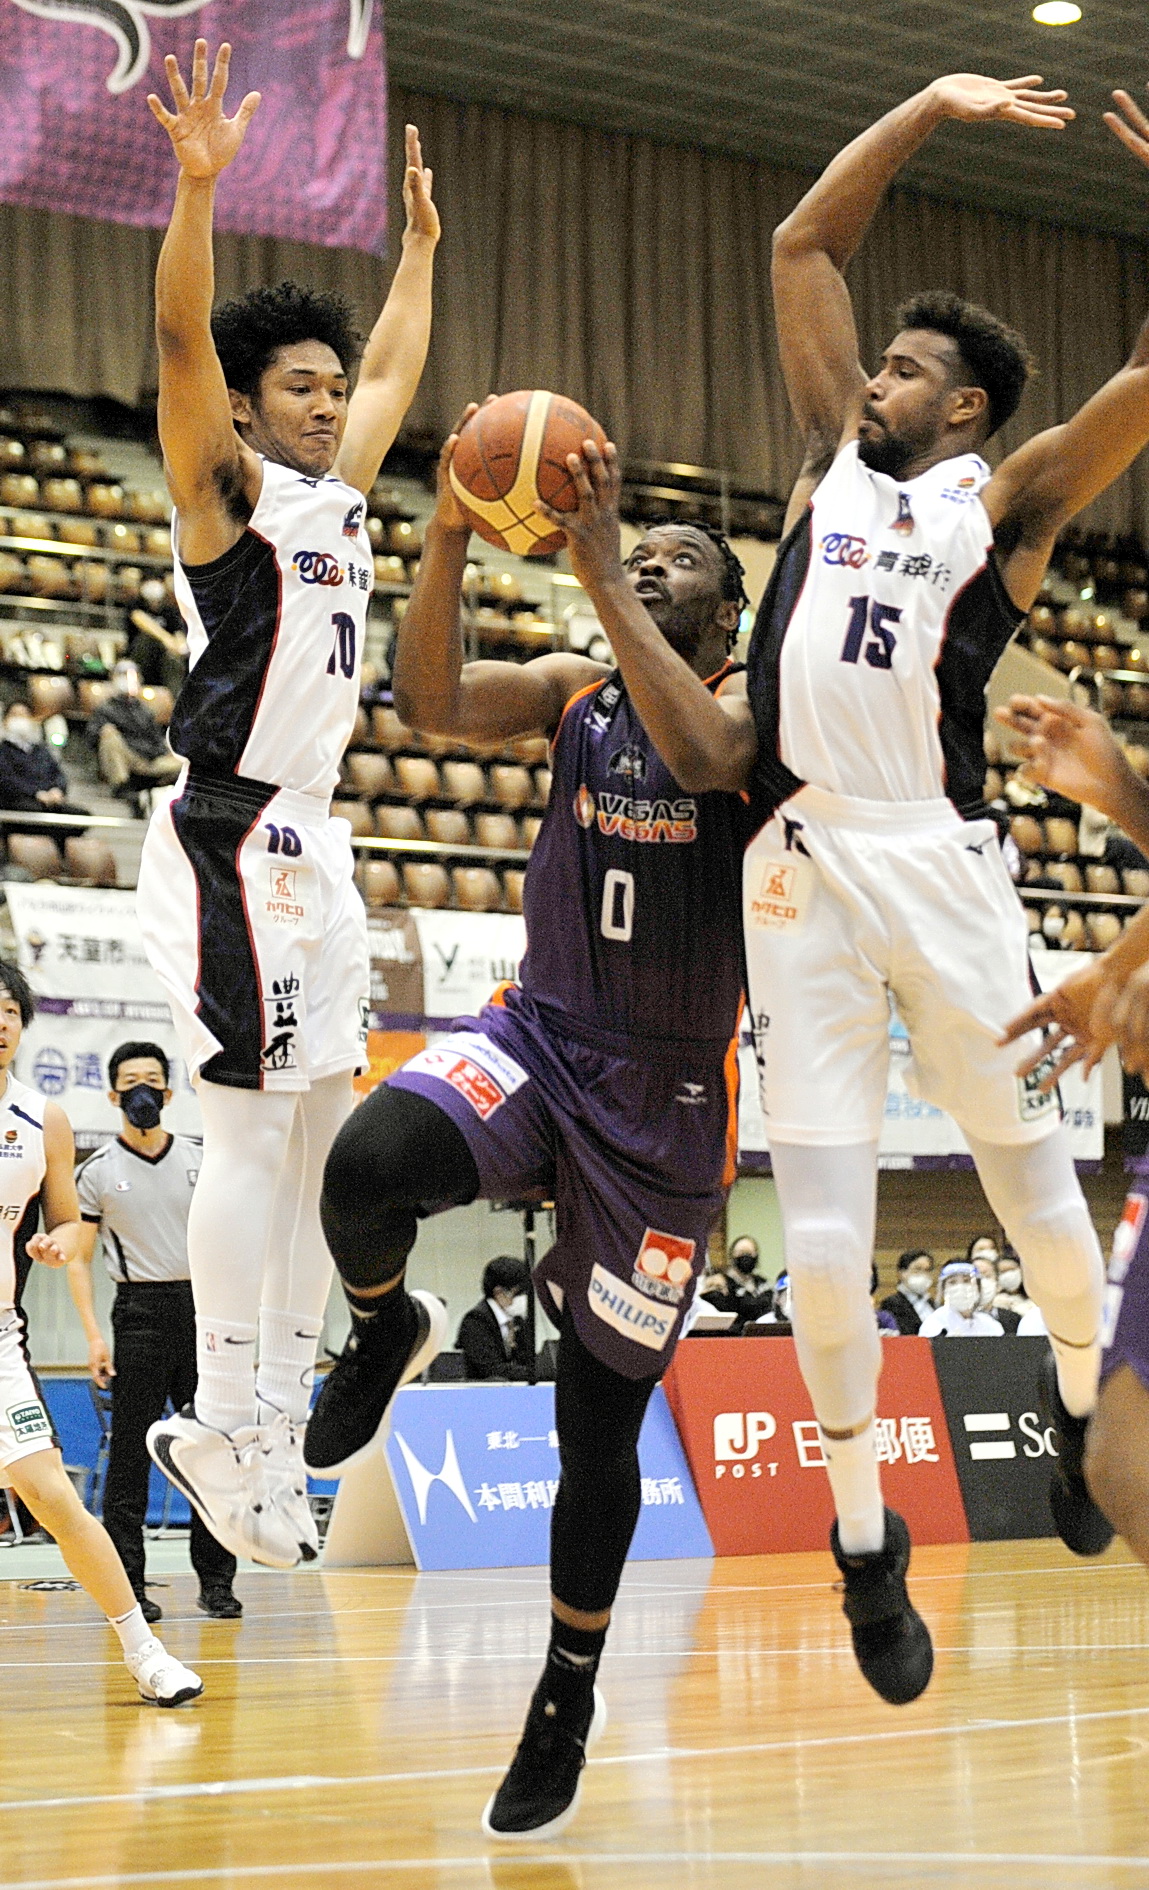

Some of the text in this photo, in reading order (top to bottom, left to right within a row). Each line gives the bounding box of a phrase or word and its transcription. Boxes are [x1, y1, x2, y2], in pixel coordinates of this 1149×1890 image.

[326, 611, 356, 680] 10
[840, 595, 903, 669] 15
[597, 811, 697, 842] VEGAS
[598, 793, 696, 822] VEGAS
[264, 823, 302, 858] 10
[265, 901, 304, 917] カクヒロ
[601, 867, 635, 942] 0
[751, 900, 797, 920] カクヒロ
[592, 1279, 666, 1336] PHILIPS
[713, 1412, 776, 1461] JP
[792, 1416, 940, 1468] 日郵便
[715, 1462, 779, 1479] POST
